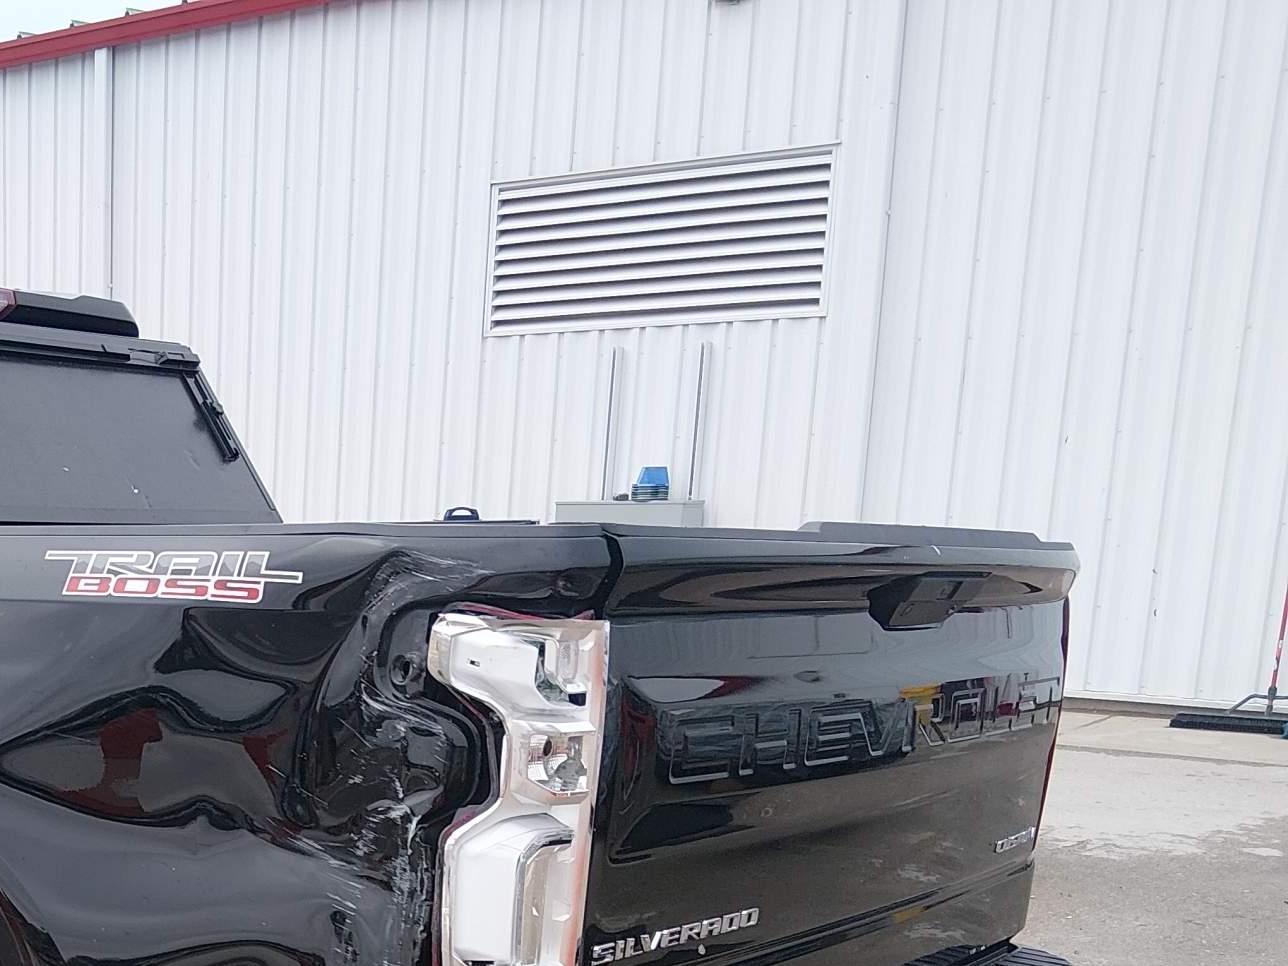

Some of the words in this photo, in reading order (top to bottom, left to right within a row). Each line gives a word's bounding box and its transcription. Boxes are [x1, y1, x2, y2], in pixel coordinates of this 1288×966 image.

[44, 549, 304, 585] TRAIL
[62, 573, 265, 604] BOSS
[668, 676, 1061, 785] CHEVROLET
[590, 907, 760, 966] SILVERADO
